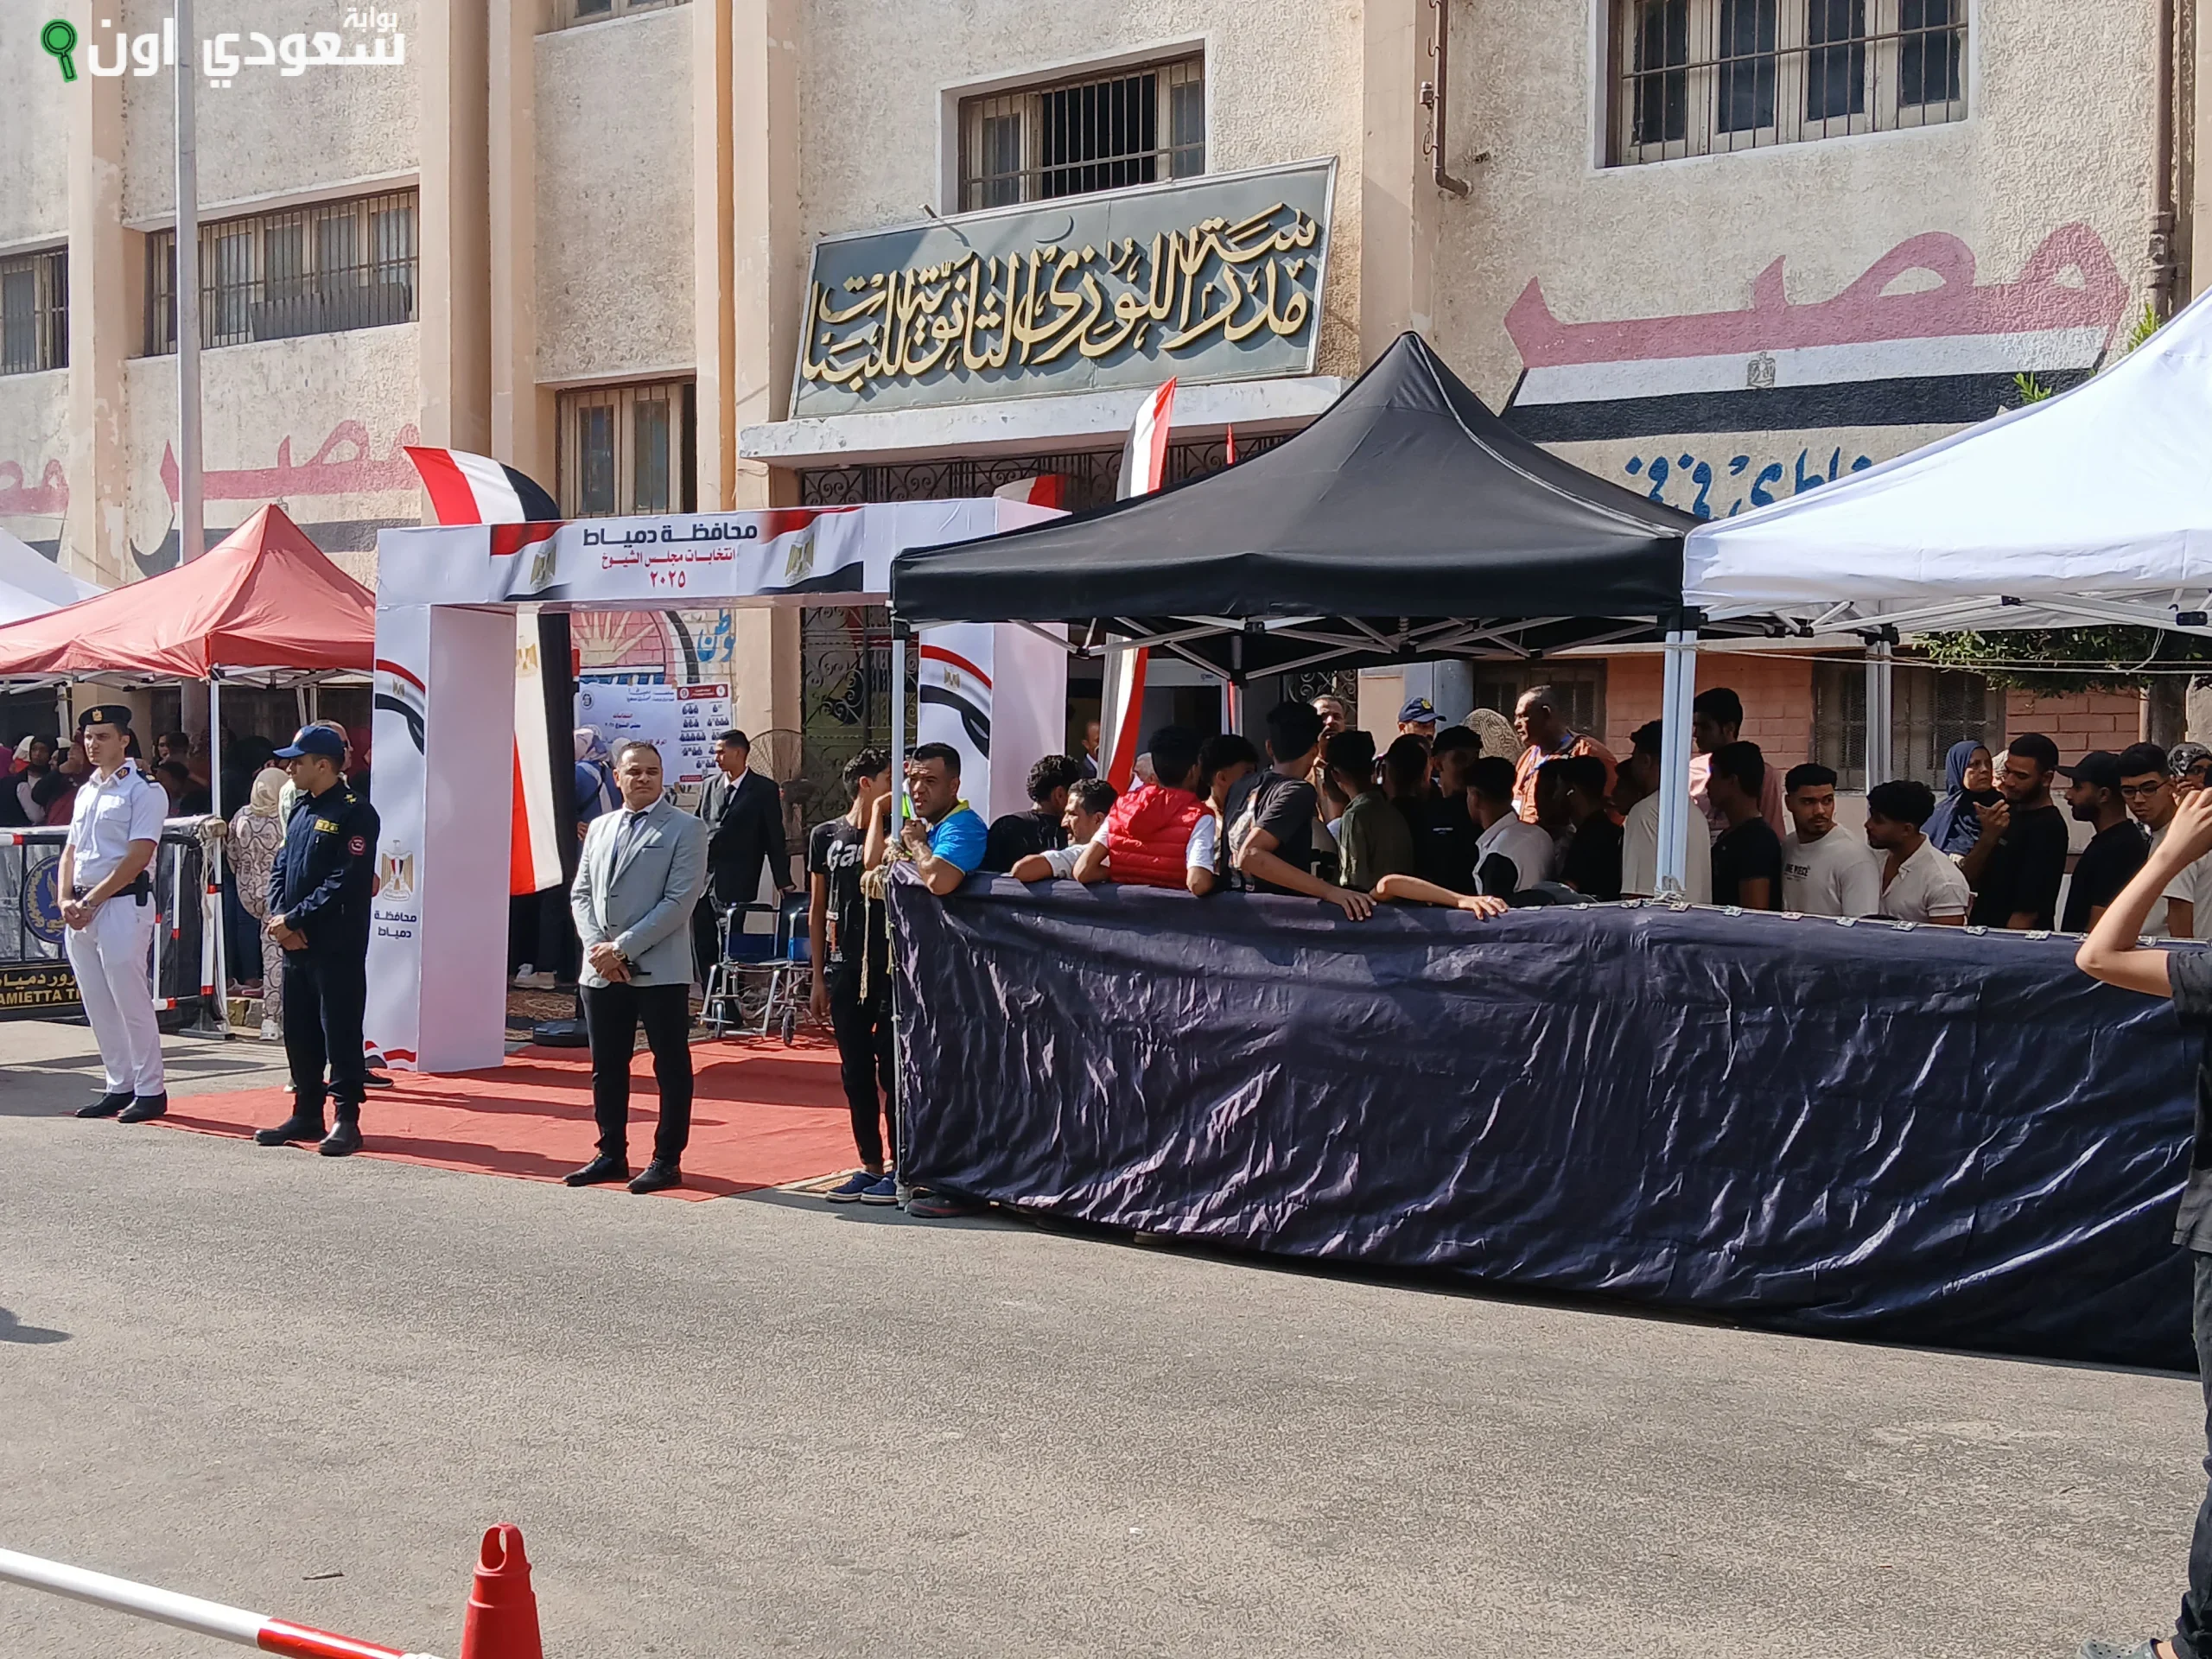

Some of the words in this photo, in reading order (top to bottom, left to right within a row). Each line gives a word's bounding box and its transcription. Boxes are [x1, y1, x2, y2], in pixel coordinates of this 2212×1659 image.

[1160, 202, 1316, 349] مدرسة
[896, 248, 1042, 376] الثانوية
[802, 268, 914, 391] للبنات
[583, 528, 657, 548] دمياط
[660, 522, 758, 543] محافظة
[601, 550, 643, 569] الشيوخ
[645, 550, 683, 567] مجلس
[684, 548, 735, 565] انتخابات
[650, 570, 686, 588] ٢٠٢٥
[374, 910, 417, 923] محافظة
[378, 926, 411, 939] دمياط
[0, 973, 46, 990] دميا
